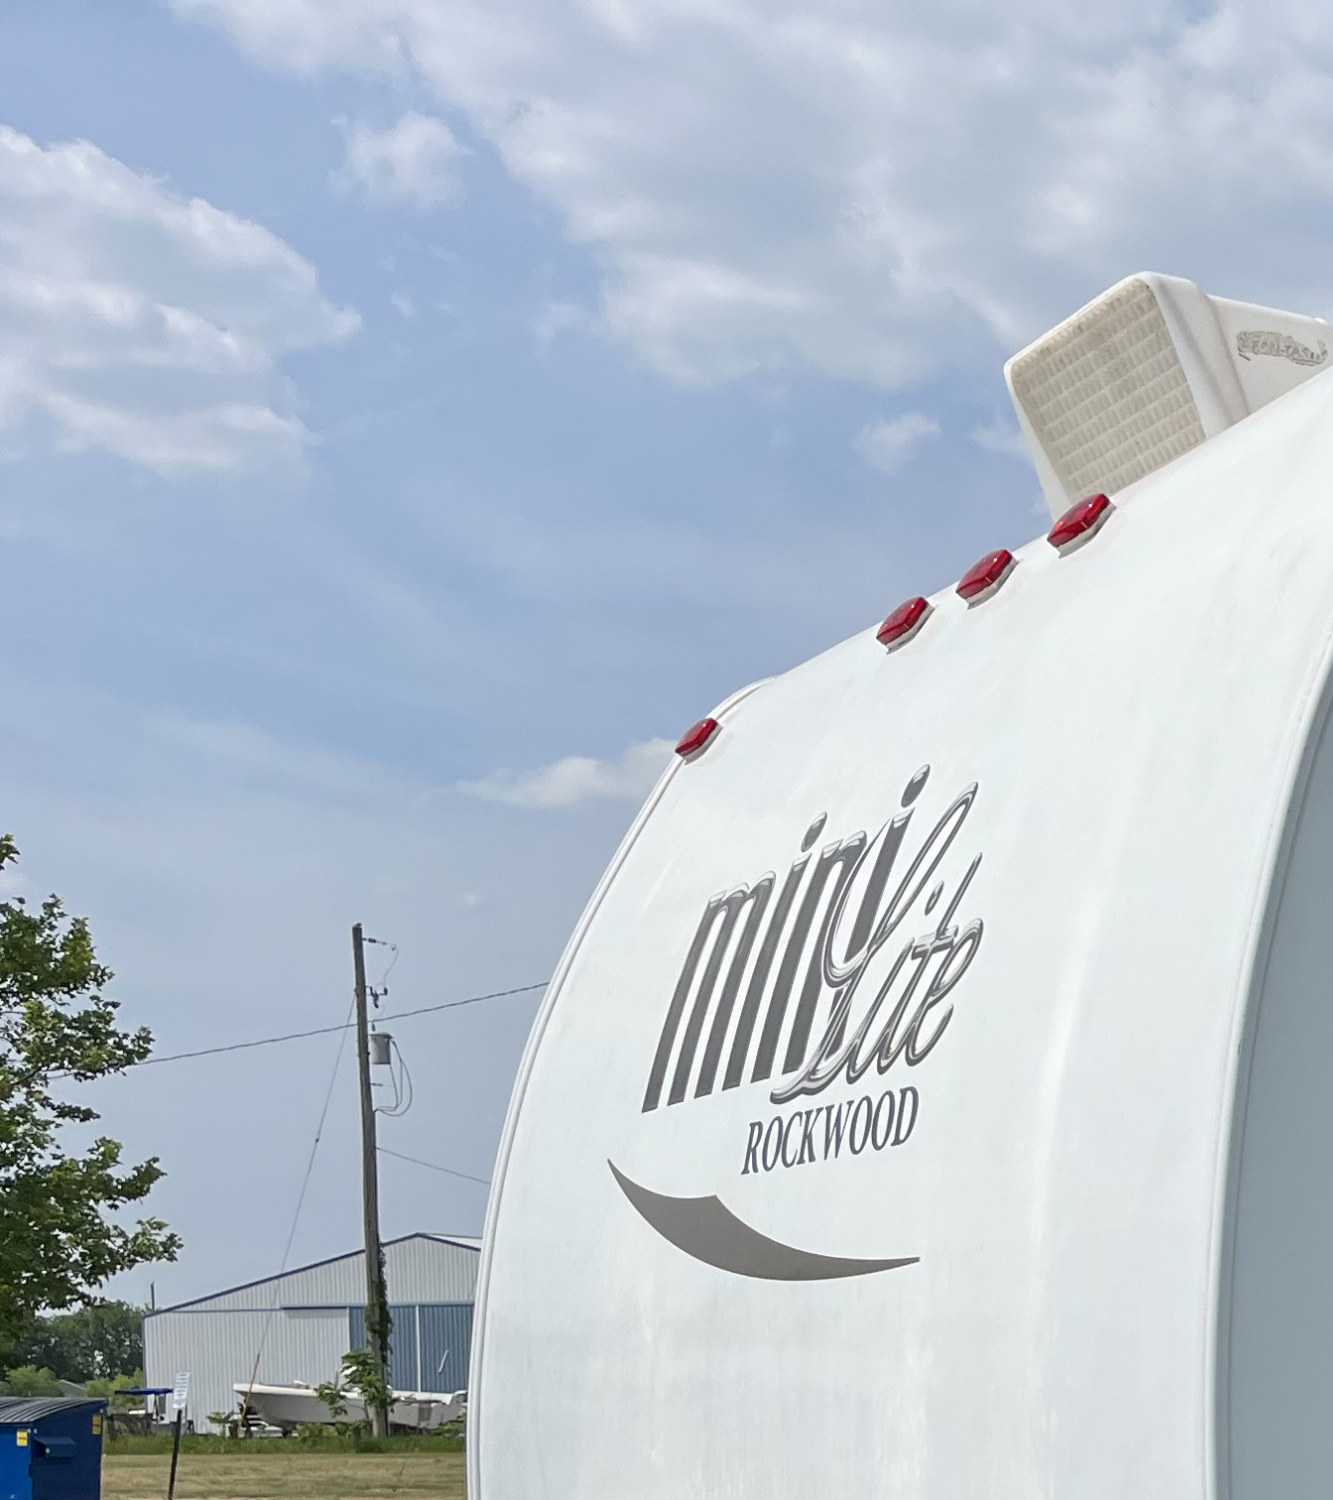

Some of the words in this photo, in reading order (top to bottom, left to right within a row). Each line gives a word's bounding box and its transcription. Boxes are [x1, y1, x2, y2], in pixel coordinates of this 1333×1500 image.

[641, 763, 930, 1113] mini
[770, 781, 984, 1104] Lite
[741, 1086, 919, 1175] ROCKWOOD
